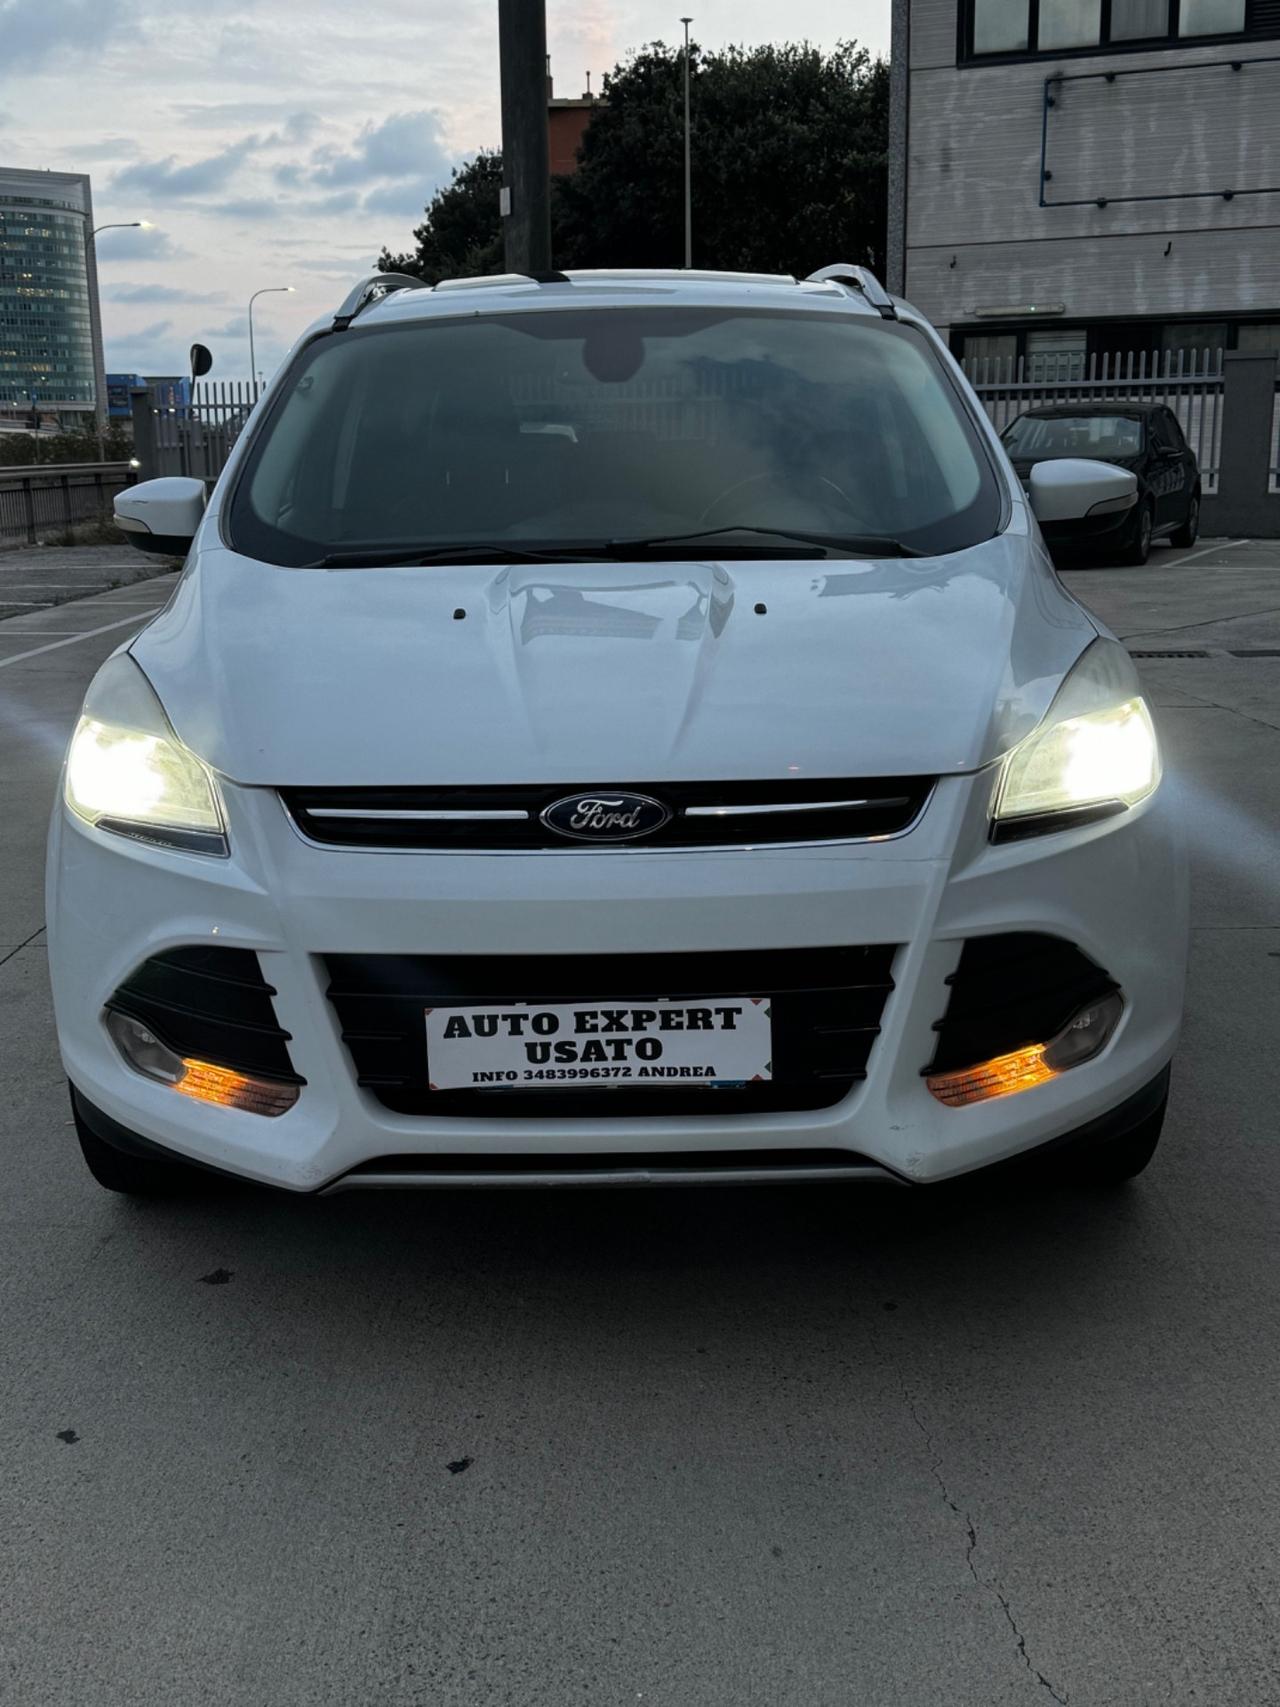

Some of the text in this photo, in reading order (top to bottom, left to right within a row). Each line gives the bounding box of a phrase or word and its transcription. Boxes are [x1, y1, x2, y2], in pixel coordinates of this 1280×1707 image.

[570, 799, 641, 829] Ford
[443, 1007, 742, 1038] AUTO EXPERT
[525, 1037, 663, 1064] USATO
[472, 1066, 717, 1083] INFO 3483996372 ANDREA
